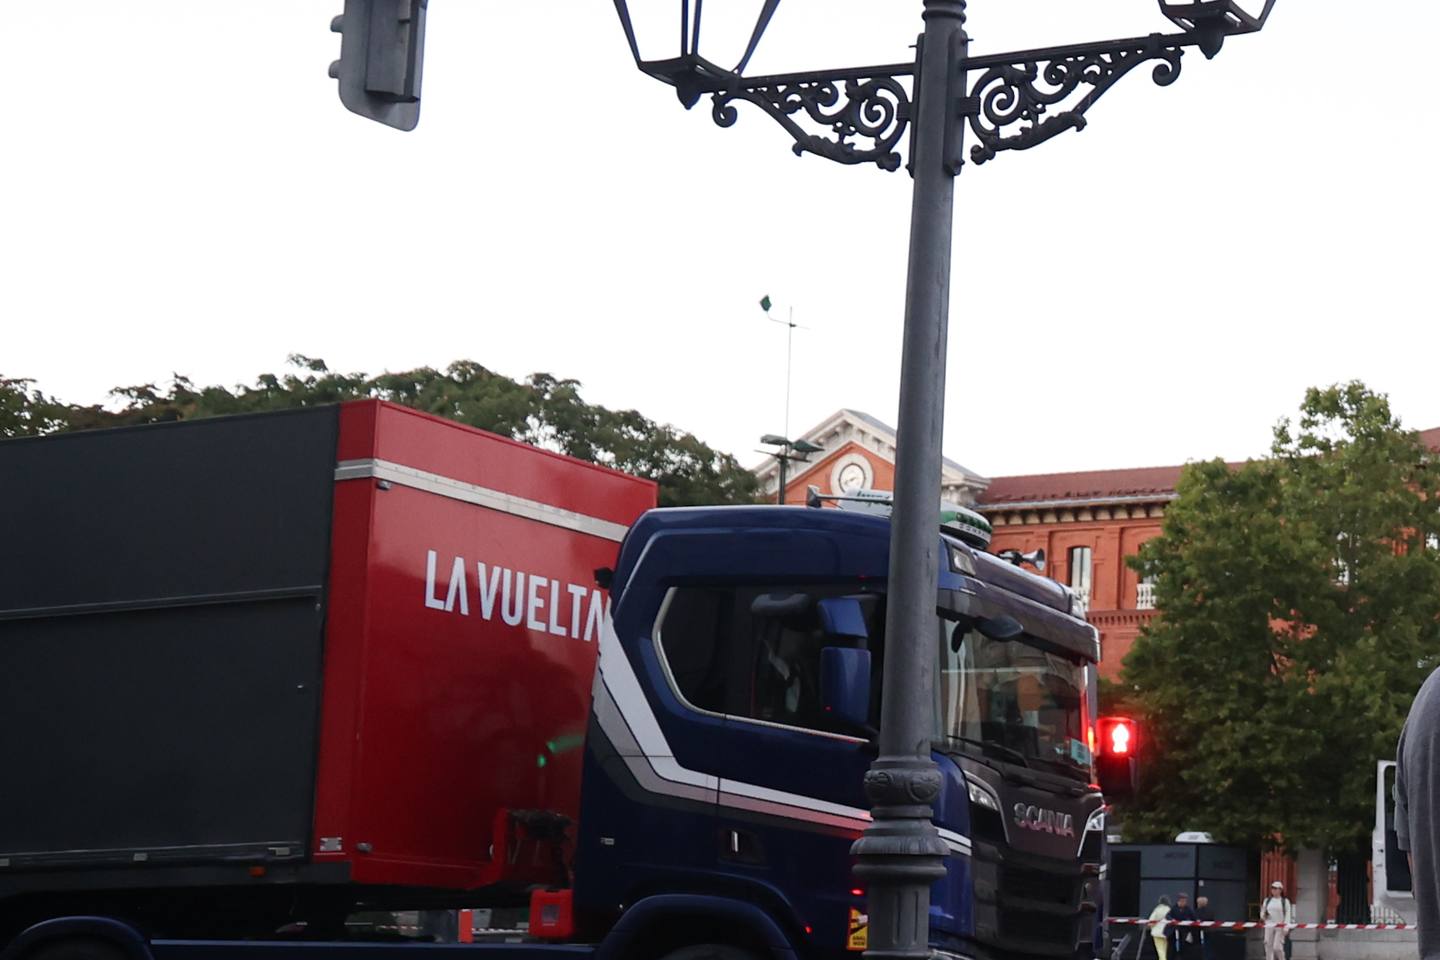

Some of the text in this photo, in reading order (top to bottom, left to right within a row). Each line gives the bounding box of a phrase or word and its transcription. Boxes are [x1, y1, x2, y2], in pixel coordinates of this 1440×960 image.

[425, 549, 608, 642] LA VUELTA
[1014, 802, 1075, 837] SCANIA
